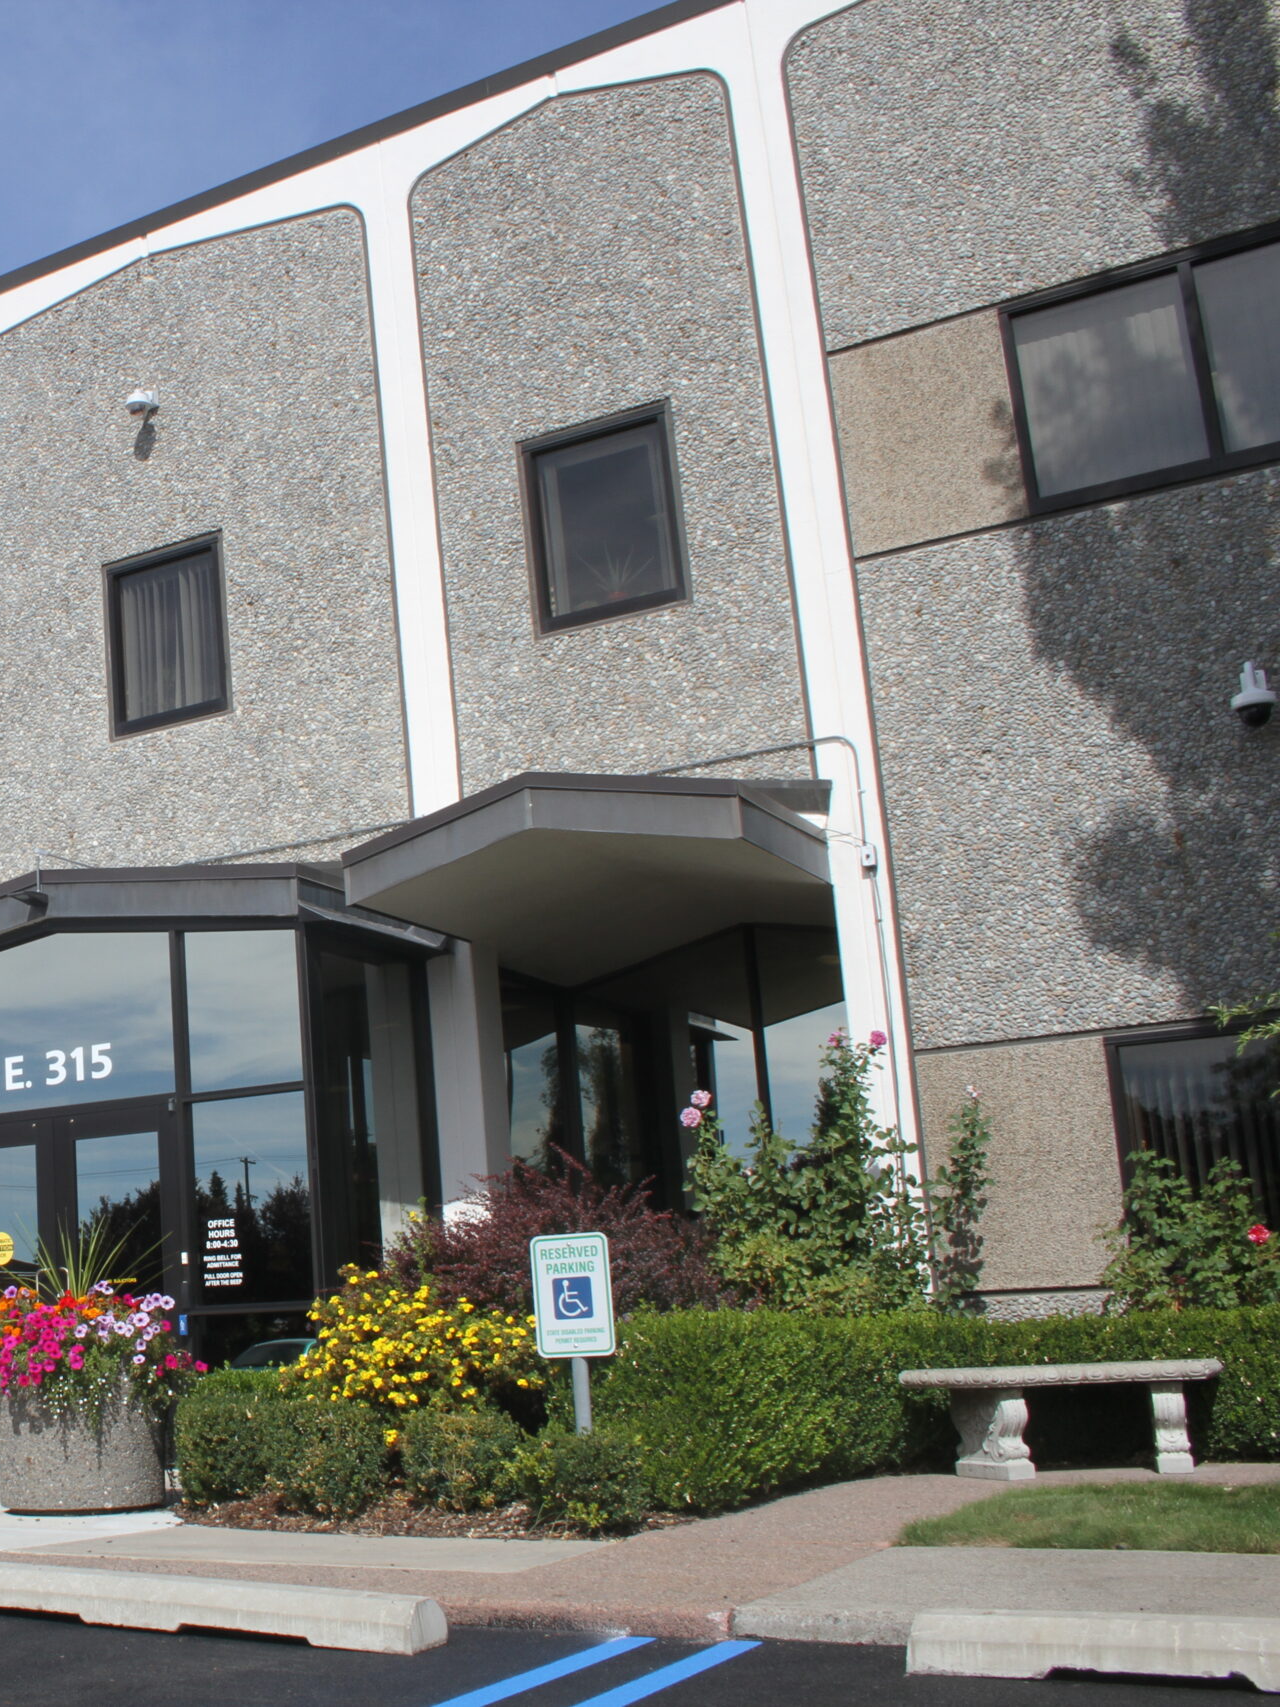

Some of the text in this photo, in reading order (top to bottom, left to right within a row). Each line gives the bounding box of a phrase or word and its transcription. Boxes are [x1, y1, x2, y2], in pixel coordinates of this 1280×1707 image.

[5, 1042, 113, 1091] E. 315
[207, 1219, 235, 1228] OFFICE
[208, 1229, 235, 1238] HOURS
[206, 1239, 238, 1249] 8:00-4:30
[540, 1245, 598, 1260] RESERVED
[546, 1260, 595, 1275] PARKING
